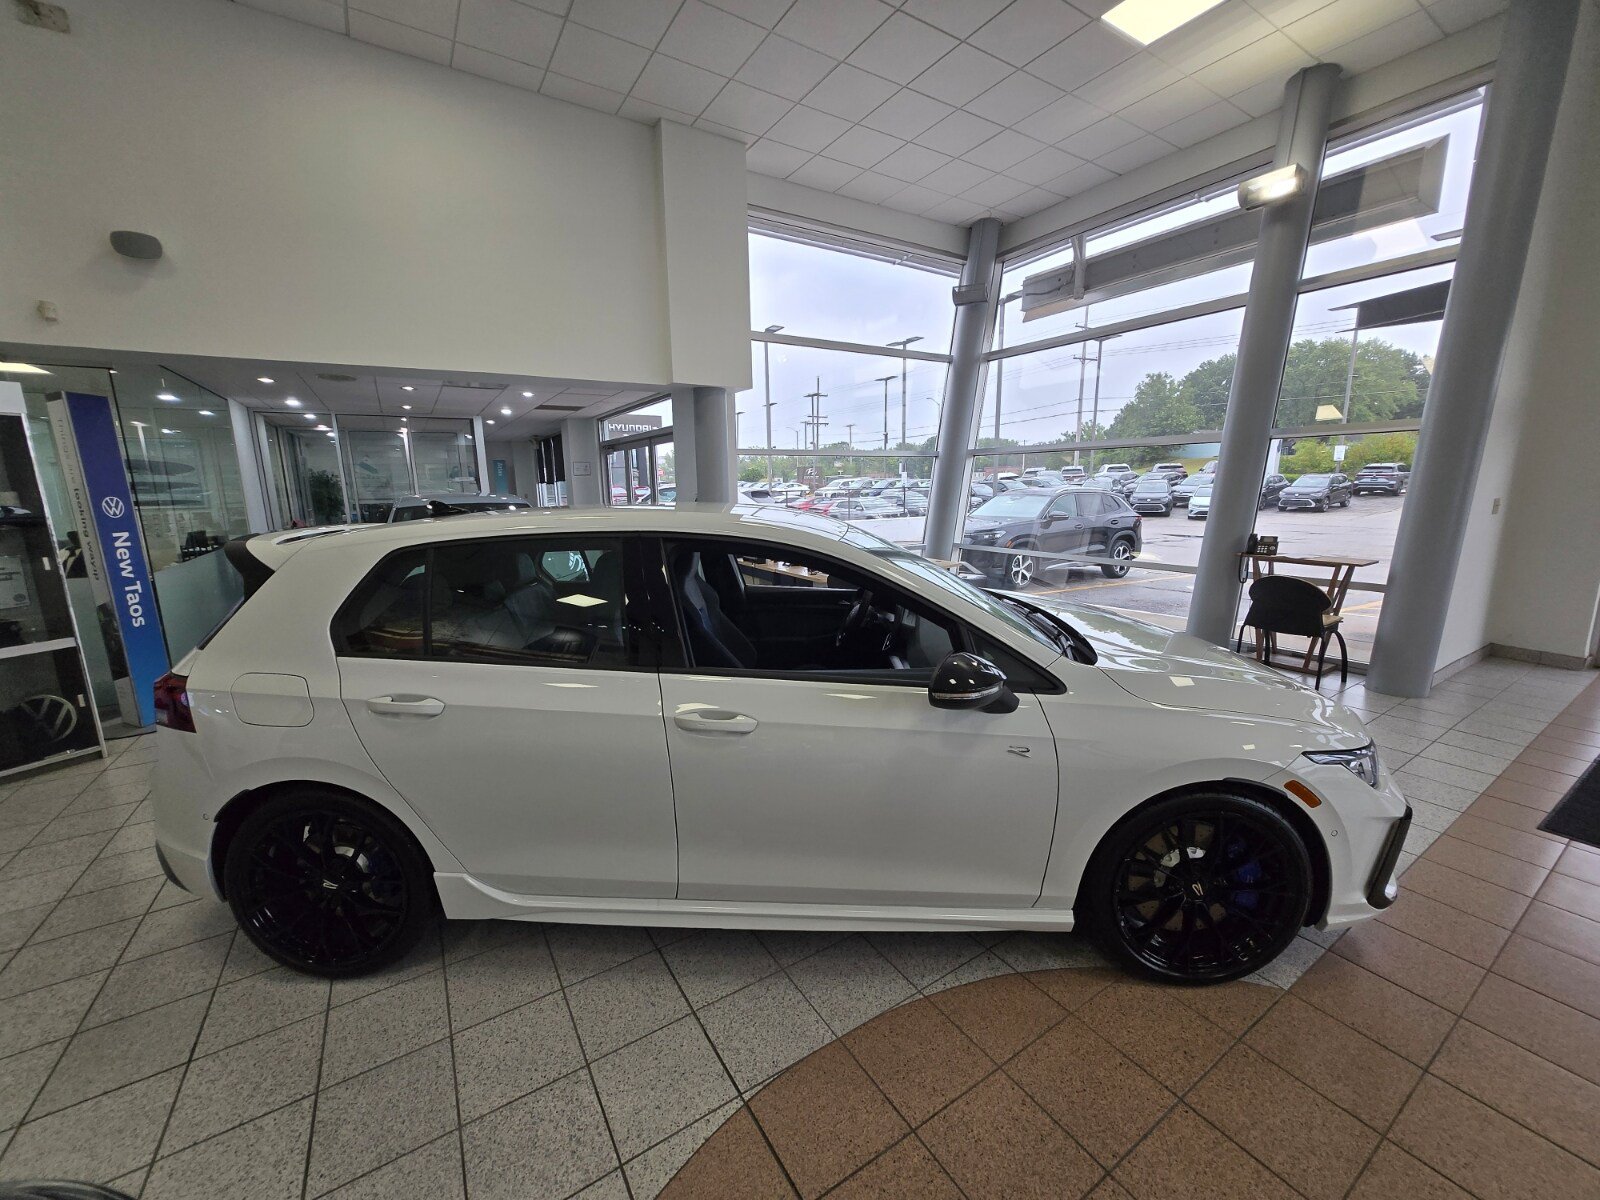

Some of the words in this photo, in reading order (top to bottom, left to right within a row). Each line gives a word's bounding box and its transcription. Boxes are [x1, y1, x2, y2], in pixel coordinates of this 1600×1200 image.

[608, 423, 652, 432] HYUNDAI
[112, 531, 134, 578] New
[125, 580, 145, 628] Taos
